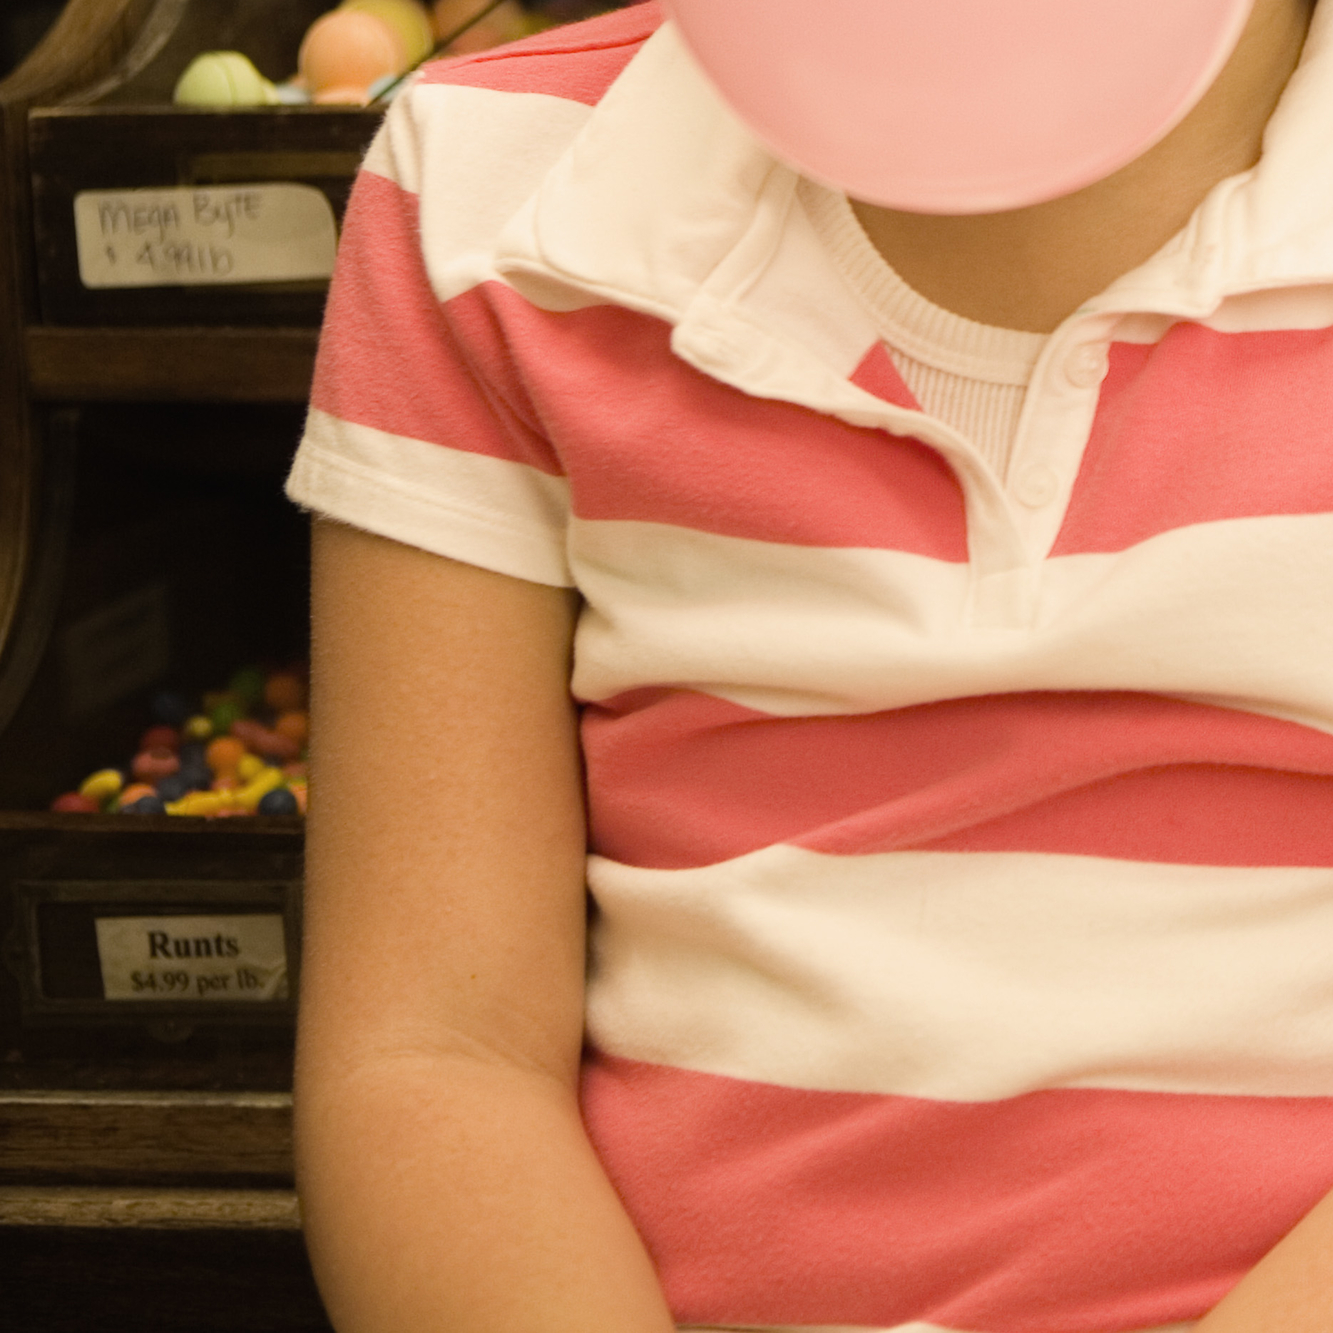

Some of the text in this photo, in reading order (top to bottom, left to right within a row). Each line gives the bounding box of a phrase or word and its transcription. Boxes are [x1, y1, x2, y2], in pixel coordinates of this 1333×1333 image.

[148, 930, 241, 960] Runts
[131, 969, 190, 993] $4.99
[196, 975, 230, 995] per
